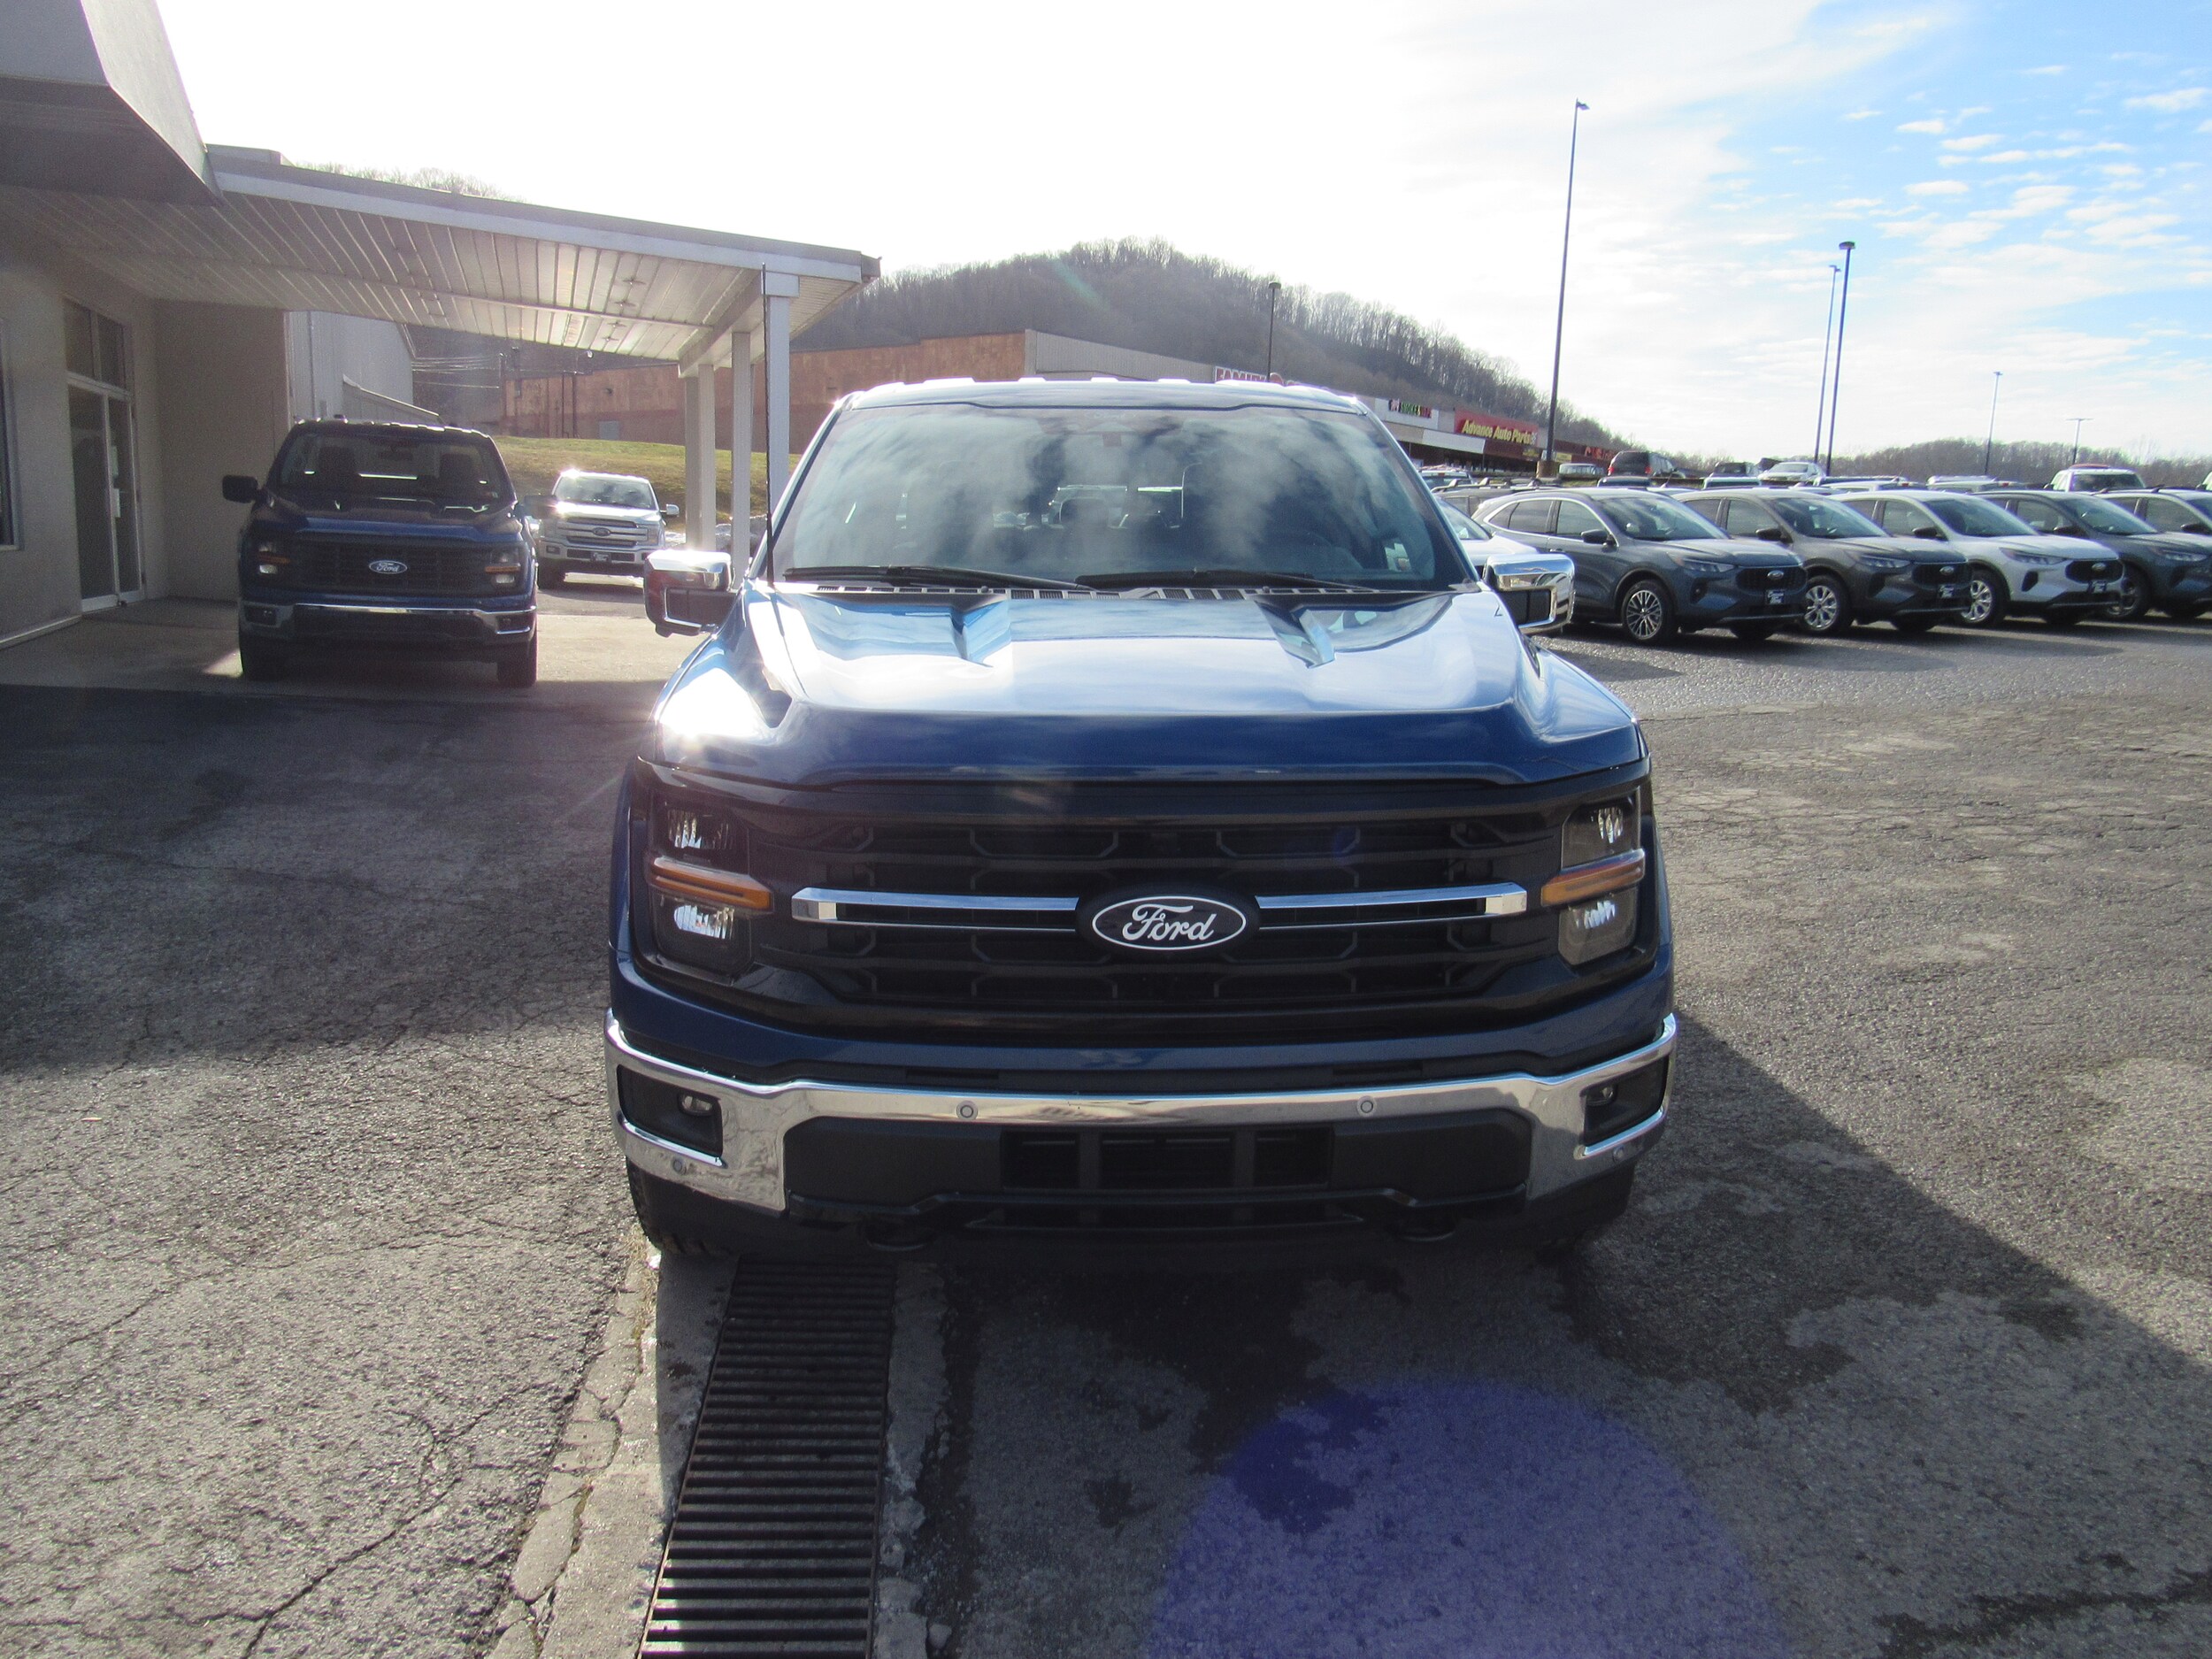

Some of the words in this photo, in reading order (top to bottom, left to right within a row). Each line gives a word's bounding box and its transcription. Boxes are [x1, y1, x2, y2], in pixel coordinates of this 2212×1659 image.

[1462, 419, 1493, 438] Advance
[1493, 426, 1512, 442] Auto
[1511, 428, 1532, 445] Parts
[376, 562, 400, 573] Ford
[1122, 903, 1217, 941] Ford
